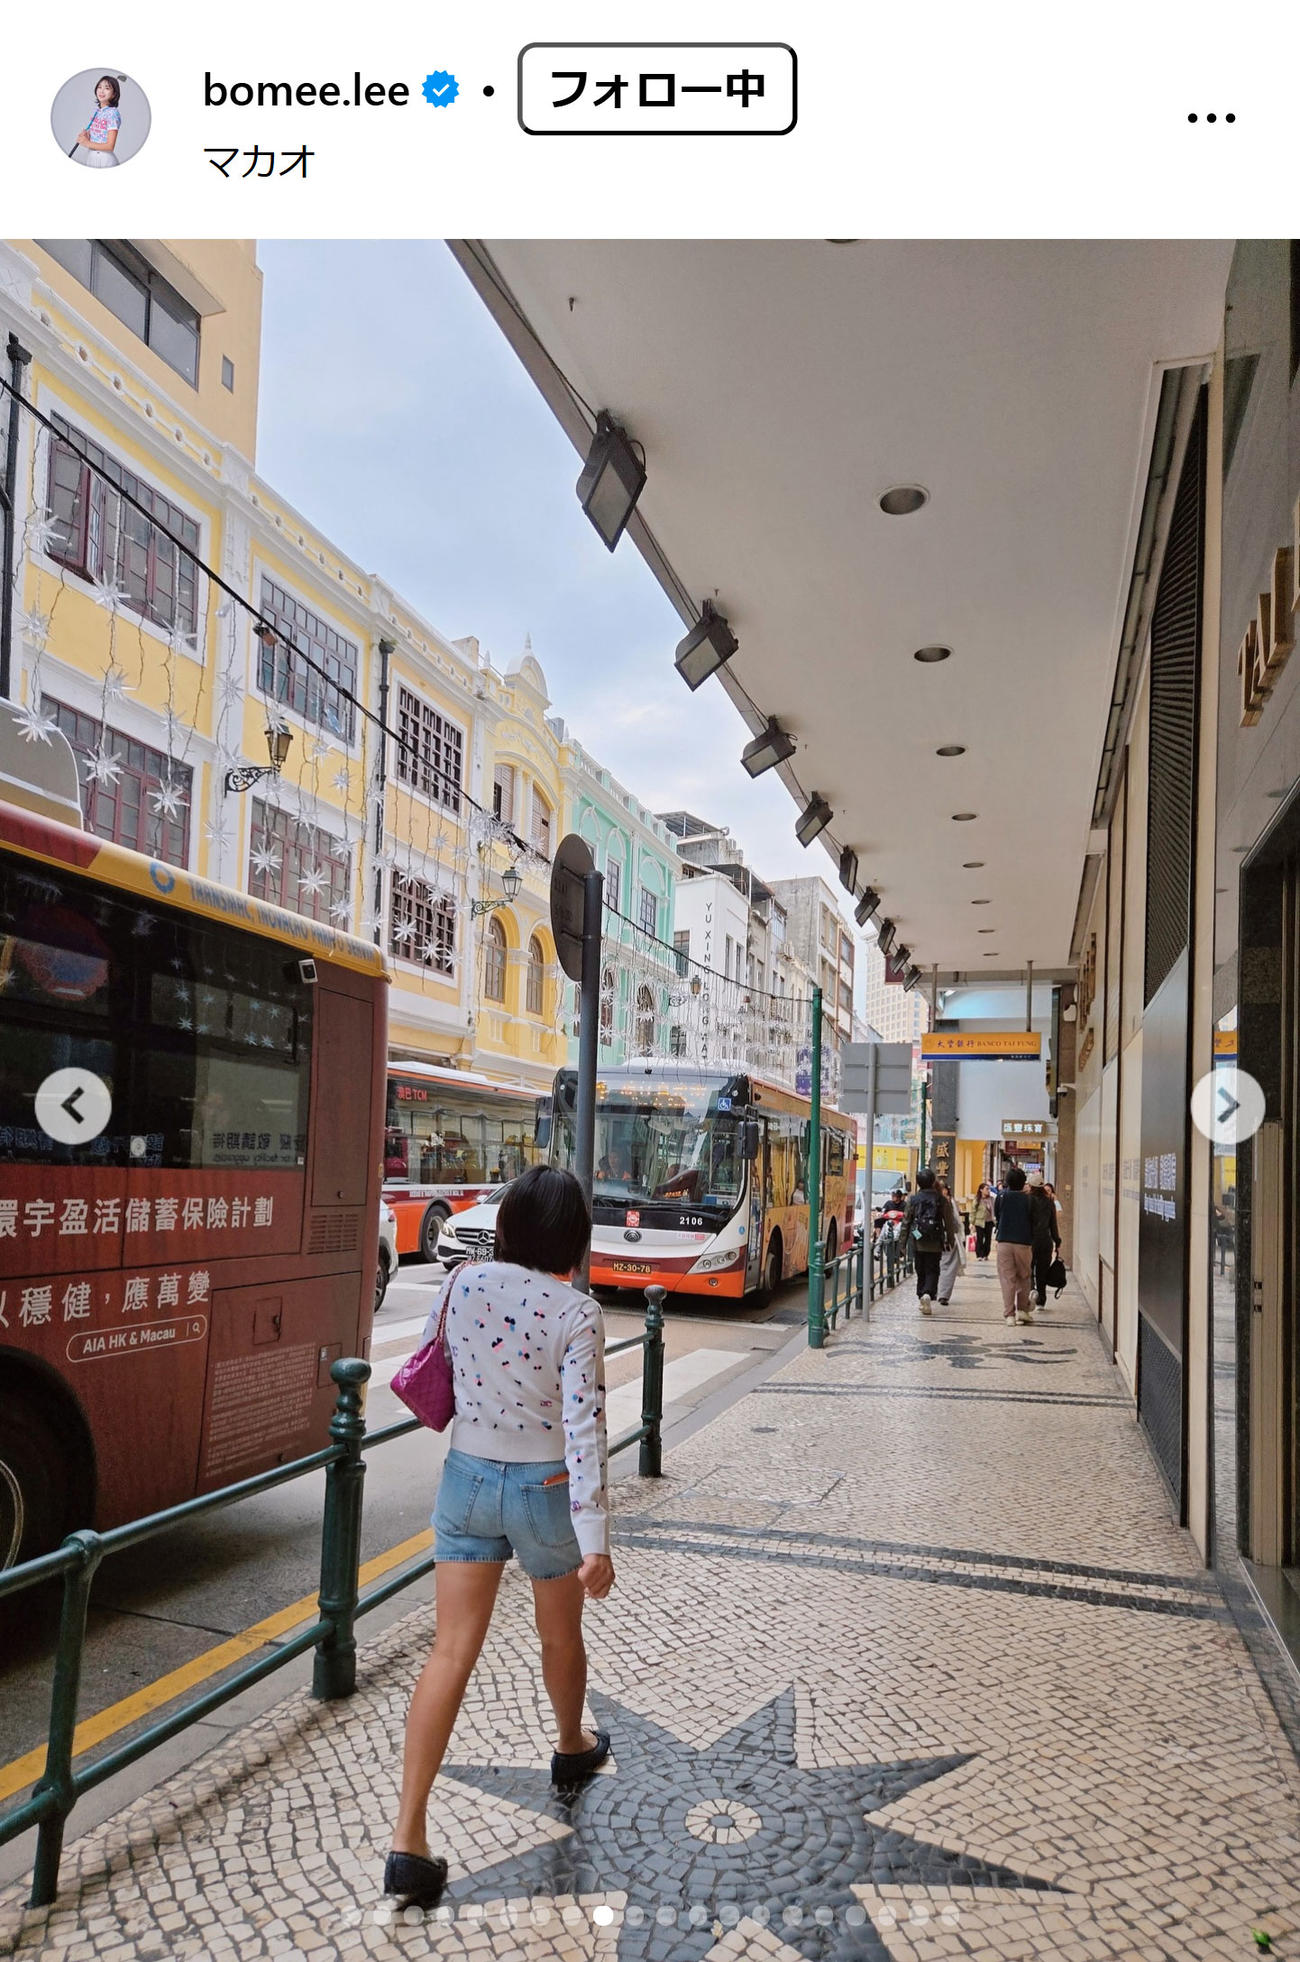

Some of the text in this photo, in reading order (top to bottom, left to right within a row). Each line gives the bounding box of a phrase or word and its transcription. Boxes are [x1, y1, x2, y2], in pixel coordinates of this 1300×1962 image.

[705, 902, 713, 924] YU
[679, 1216, 704, 1226] 2106
[83, 1328, 176, 1355] AIA HK & Macau
